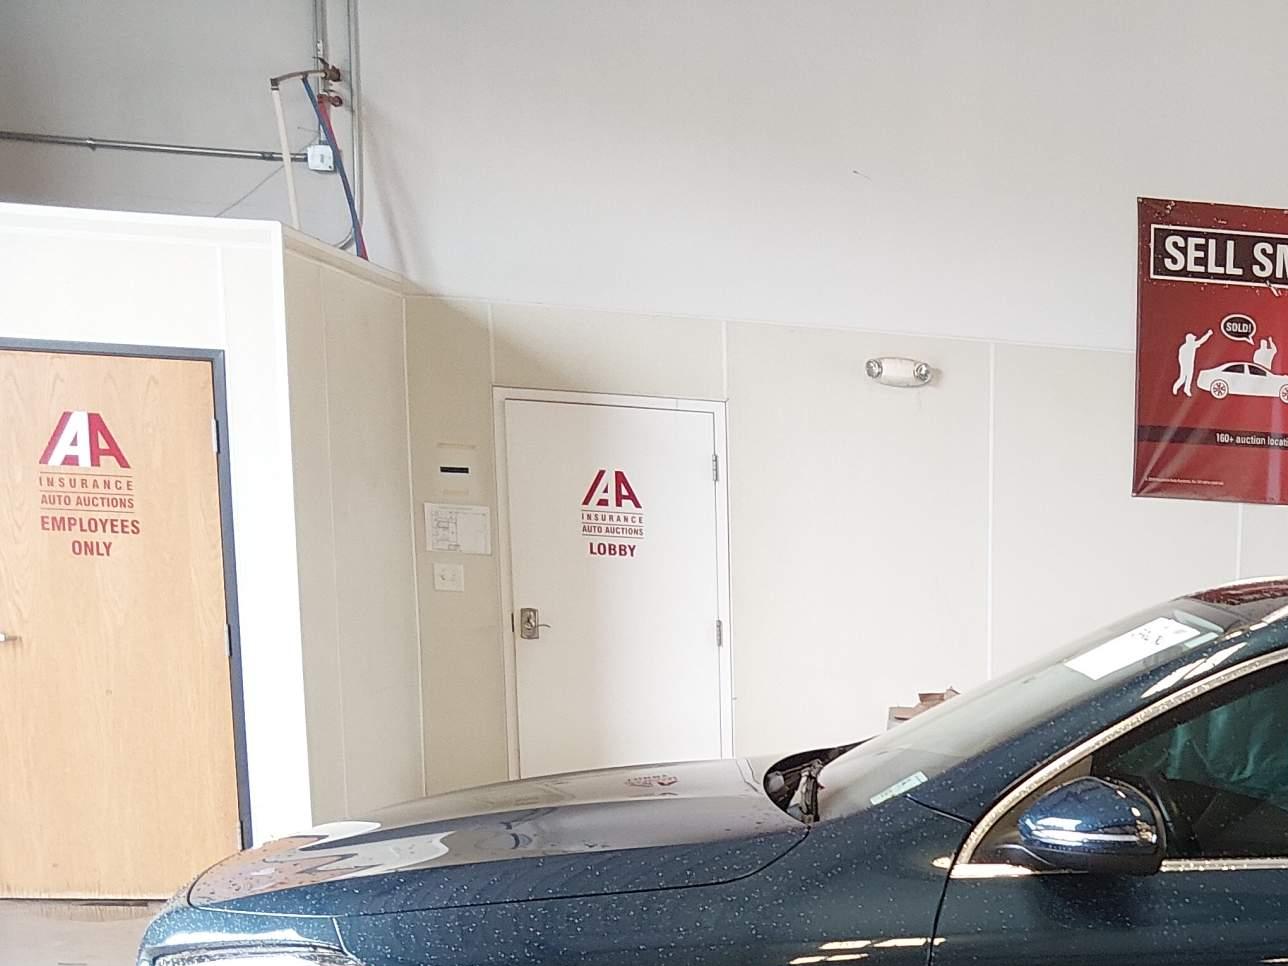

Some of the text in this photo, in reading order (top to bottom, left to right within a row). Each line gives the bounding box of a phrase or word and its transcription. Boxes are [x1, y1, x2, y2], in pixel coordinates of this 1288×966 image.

[1164, 235, 1243, 275] SELL
[1226, 321, 1251, 333] SOLD!
[1215, 433, 1234, 443] 160+
[1236, 435, 1265, 445] auction
[39, 476, 134, 491] INSURANCE
[40, 494, 135, 509] AUTO AUCTIONS
[40, 515, 141, 535] EMPLOYEES
[581, 513, 644, 524] INSURANCE
[582, 525, 644, 536] AUTO AUCTIONS
[71, 540, 113, 557] ONLY
[589, 542, 636, 557] LOBBY
